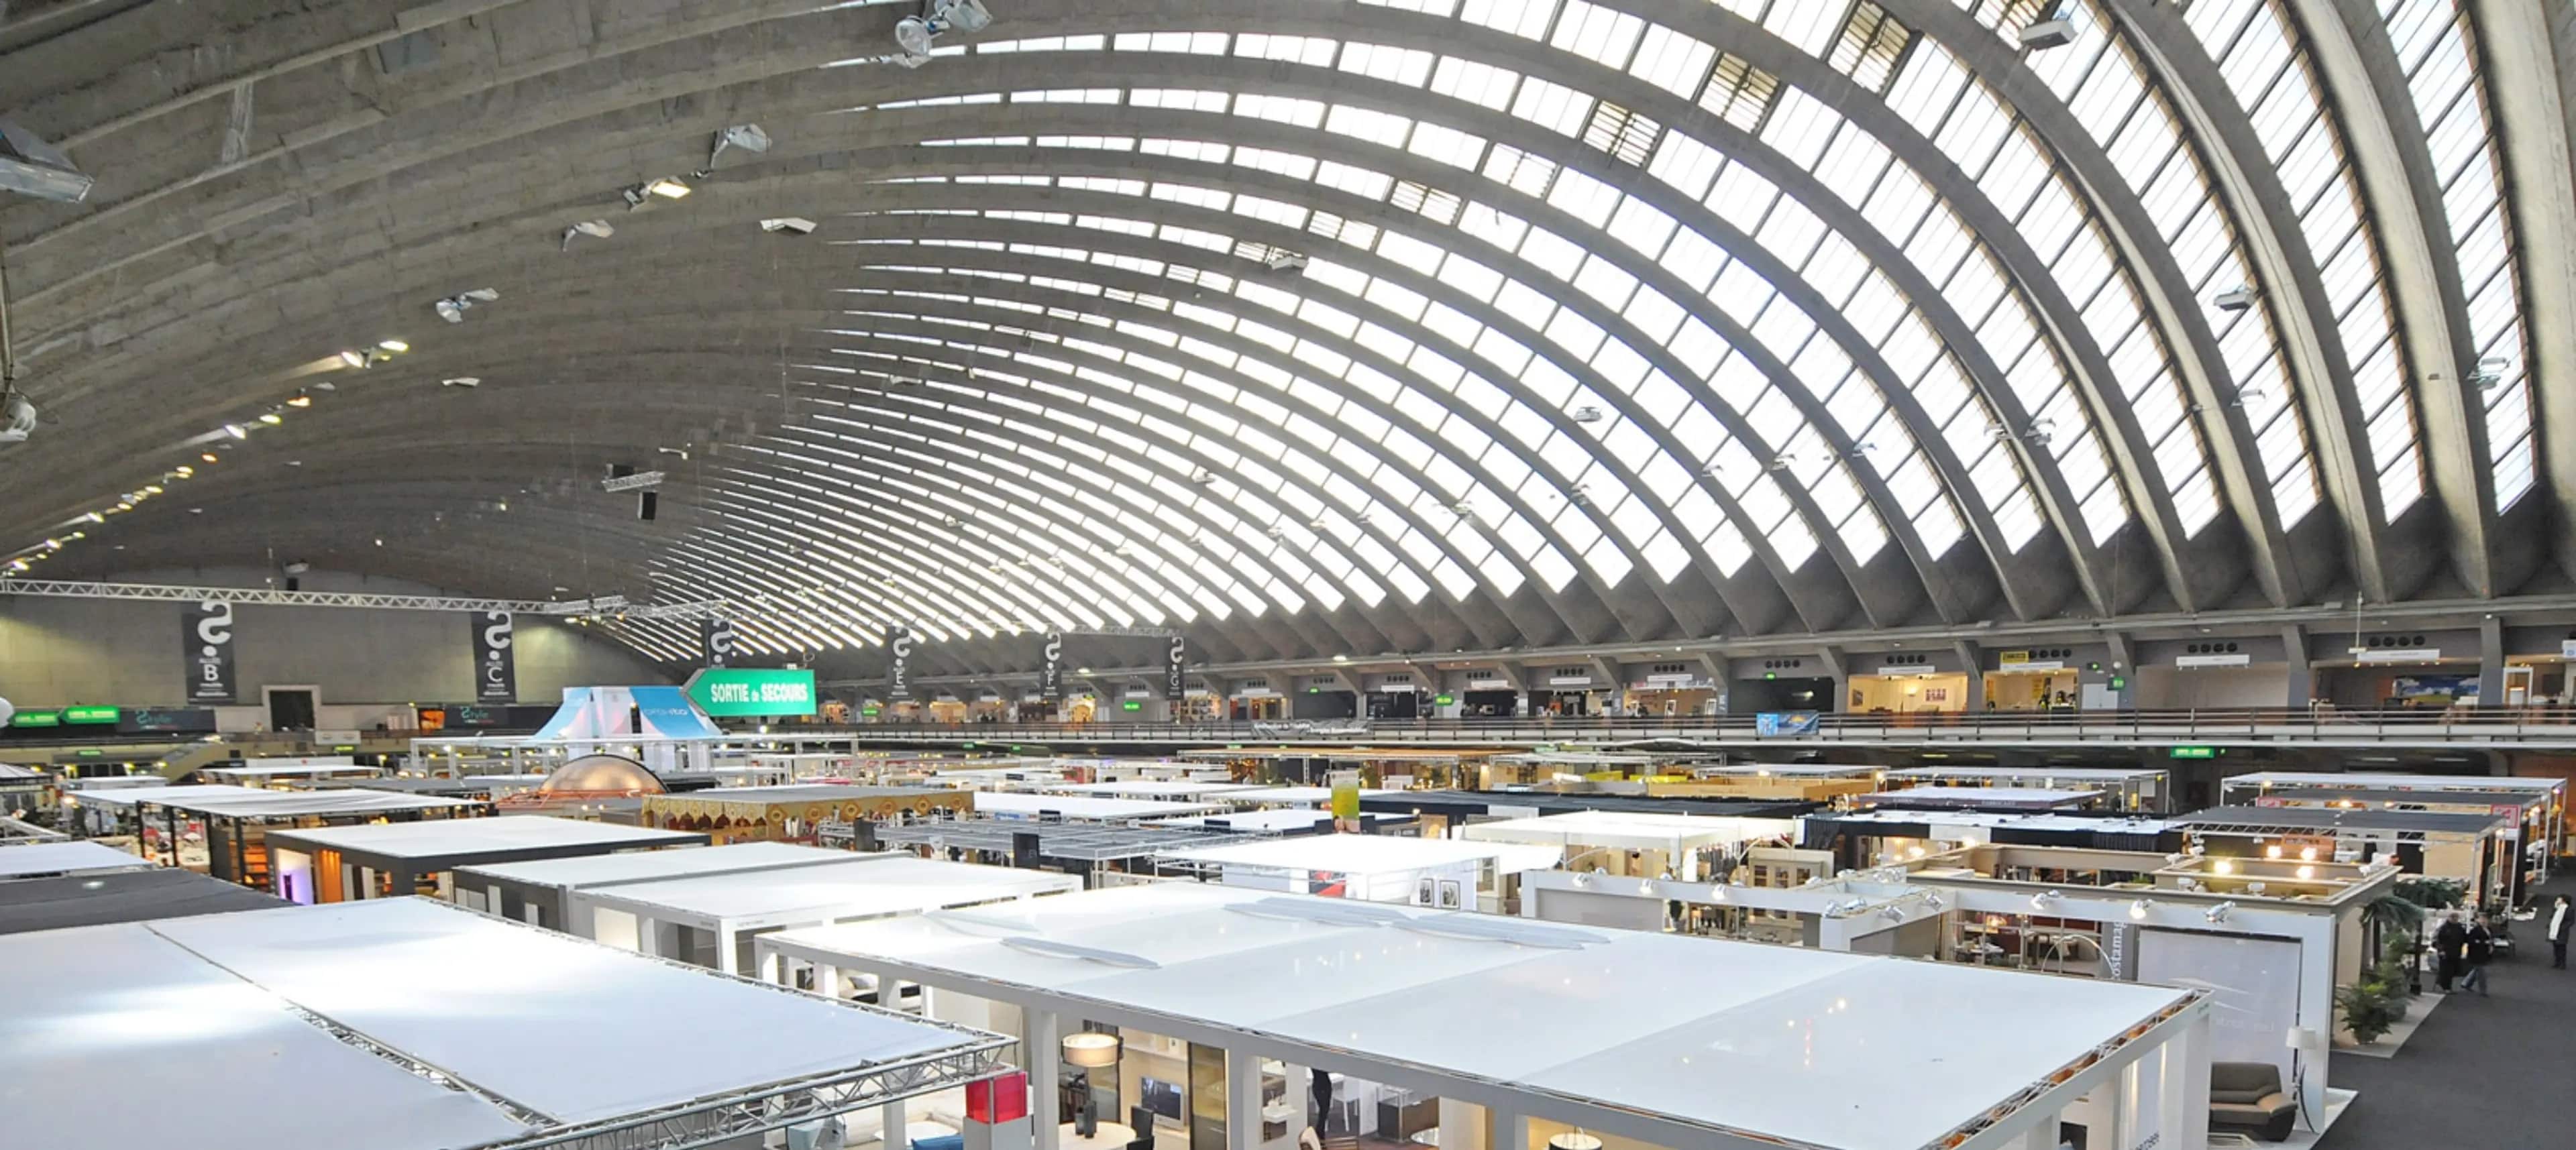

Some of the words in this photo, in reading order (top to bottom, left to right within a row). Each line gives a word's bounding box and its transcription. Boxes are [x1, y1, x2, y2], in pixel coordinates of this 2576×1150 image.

[204, 664, 219, 681] B
[488, 667, 504, 683] C
[896, 672, 904, 685] E
[1047, 674, 1054, 686] F
[1170, 675, 1179, 687] G
[710, 683, 749, 703] SORTIE
[761, 683, 808, 702] SECOURS
